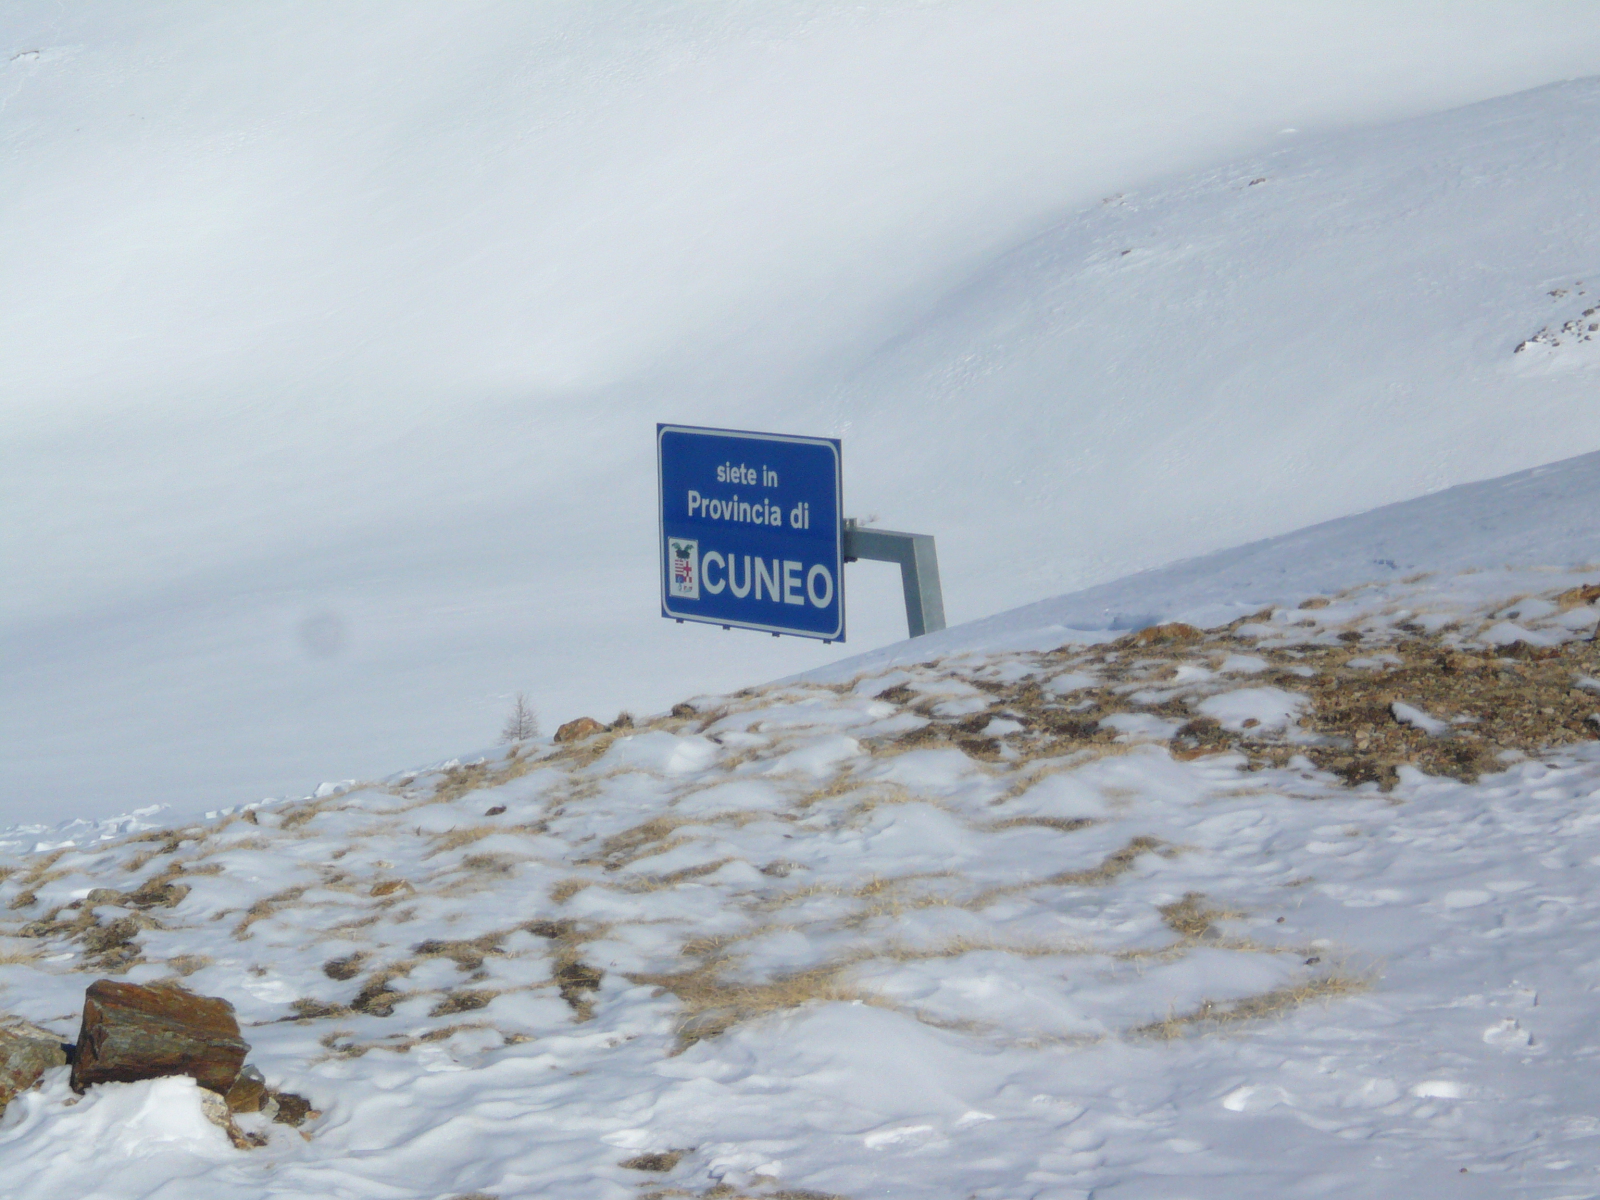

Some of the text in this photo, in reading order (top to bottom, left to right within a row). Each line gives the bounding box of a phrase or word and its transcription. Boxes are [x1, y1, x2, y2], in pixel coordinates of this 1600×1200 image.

[716, 461, 778, 487] siete in
[687, 490, 809, 529] Provincia di
[701, 550, 834, 609] CUNEO
